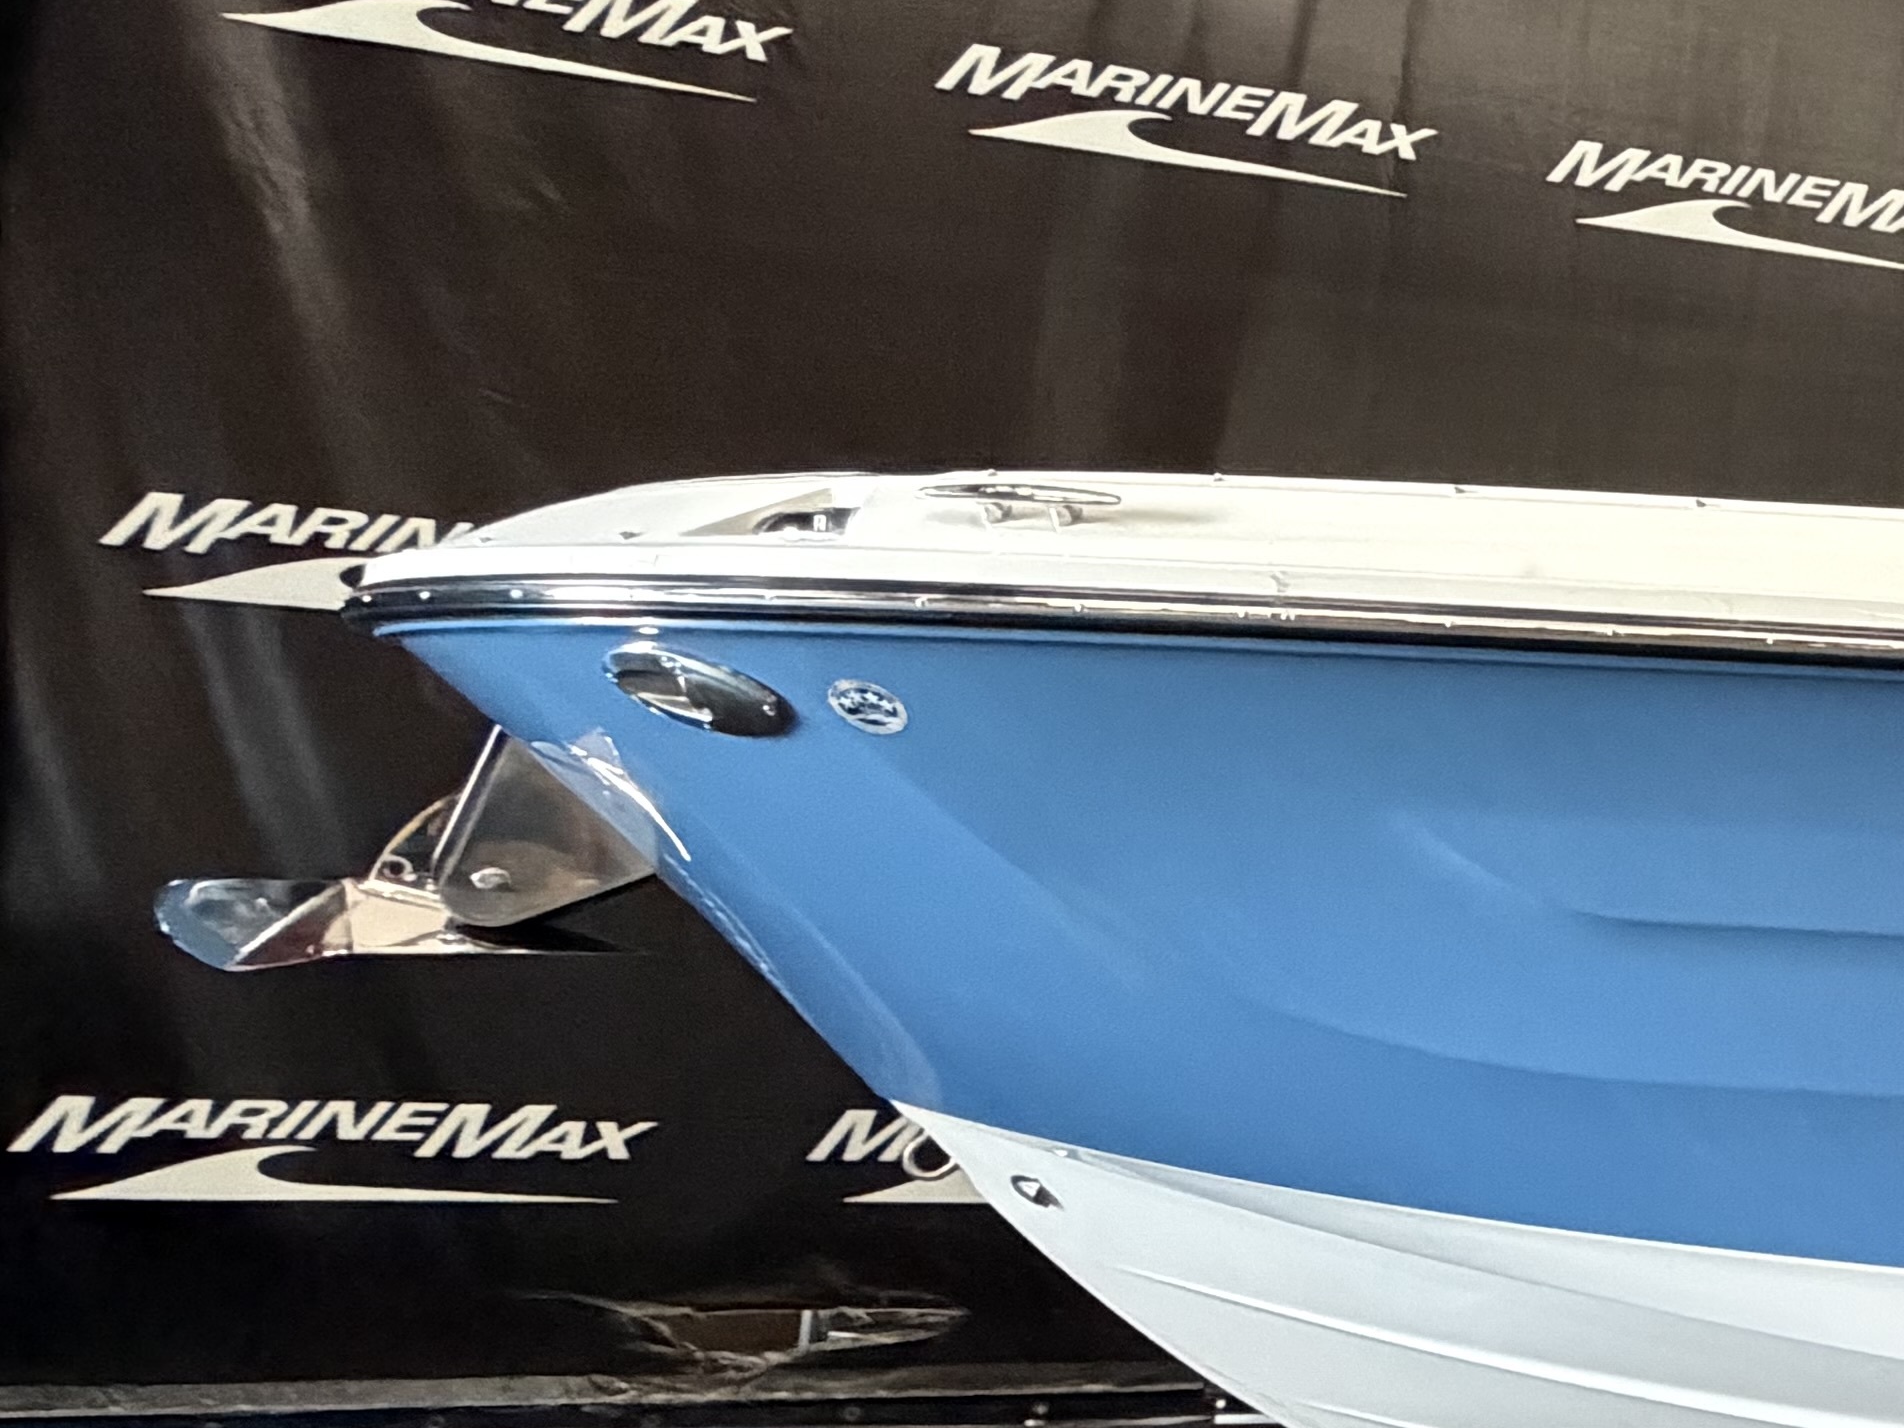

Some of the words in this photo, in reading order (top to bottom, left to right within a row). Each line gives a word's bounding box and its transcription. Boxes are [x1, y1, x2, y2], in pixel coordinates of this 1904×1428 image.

[935, 43, 1438, 161] MARINEMAX
[99, 491, 476, 553] MARIN
[8, 1095, 657, 1160] MARINEMAX
